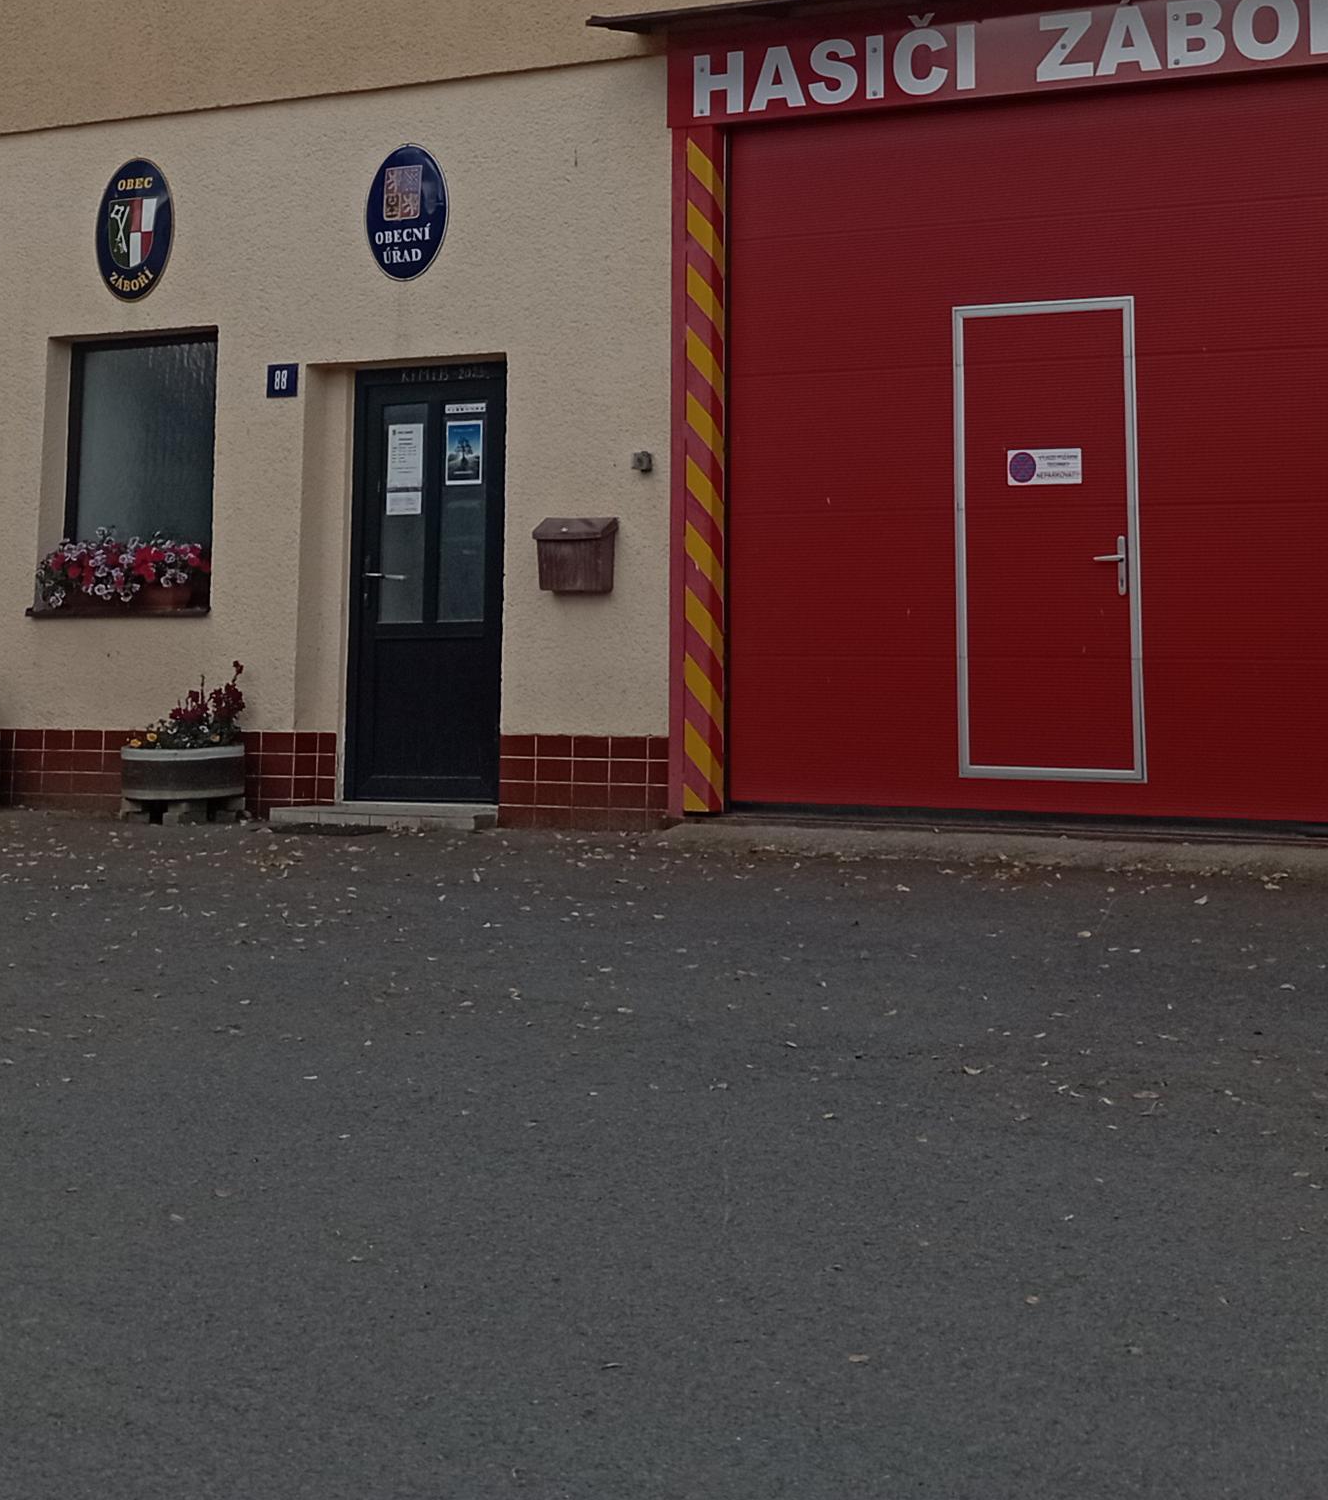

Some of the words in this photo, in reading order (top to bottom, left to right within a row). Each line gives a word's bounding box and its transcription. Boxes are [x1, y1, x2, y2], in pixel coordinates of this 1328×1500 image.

[693, 12, 976, 118] HASIČI
[117, 176, 154, 192] OBEC
[374, 223, 432, 245] OBECNÍ
[382, 247, 422, 265] ÚŘAD
[109, 267, 154, 292] ZÁBOŘÍ
[273, 369, 288, 390] 88
